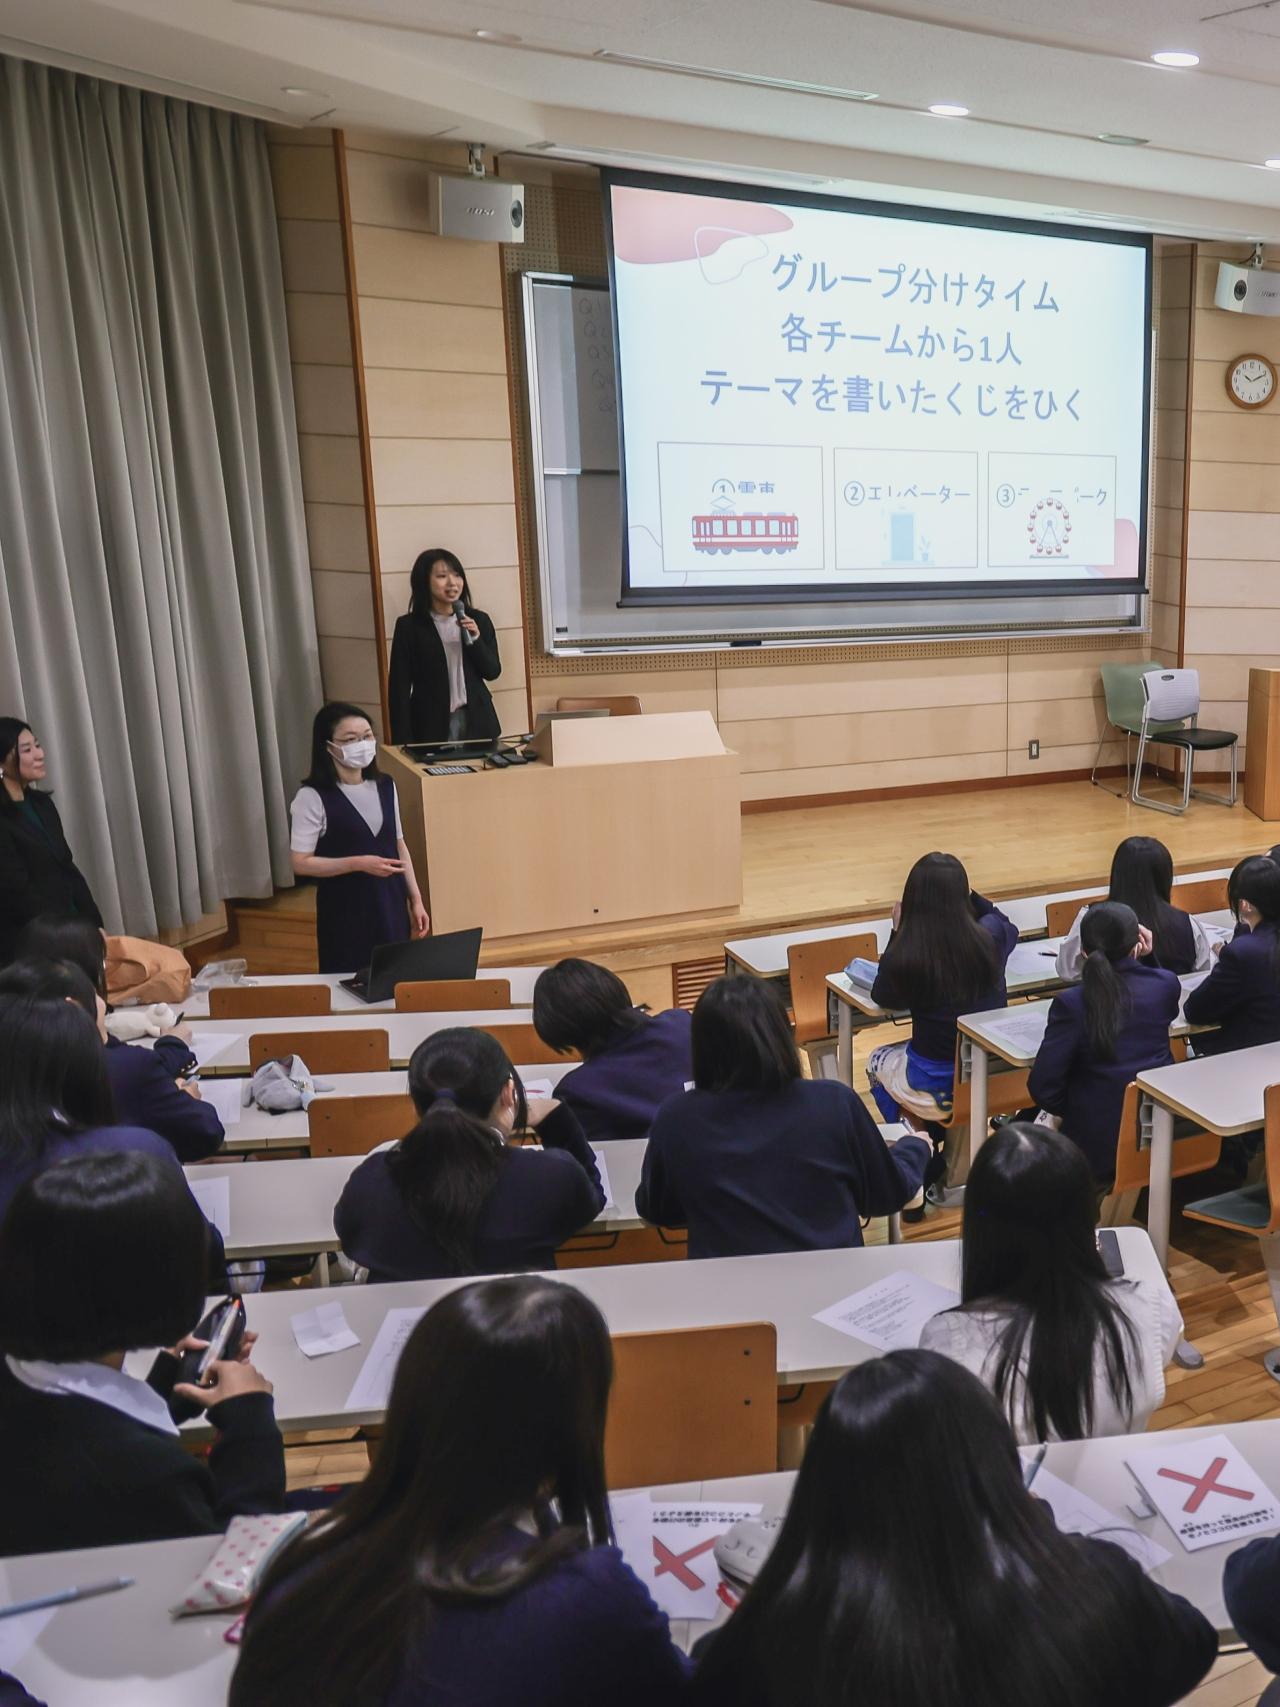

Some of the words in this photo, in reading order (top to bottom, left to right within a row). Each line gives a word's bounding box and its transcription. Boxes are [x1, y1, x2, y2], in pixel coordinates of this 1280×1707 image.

[771, 253, 1060, 313] グループ分けタイム
[780, 312, 1023, 366] 各チームから1人
[700, 370, 1082, 422] テーマを書いたくじをひく
